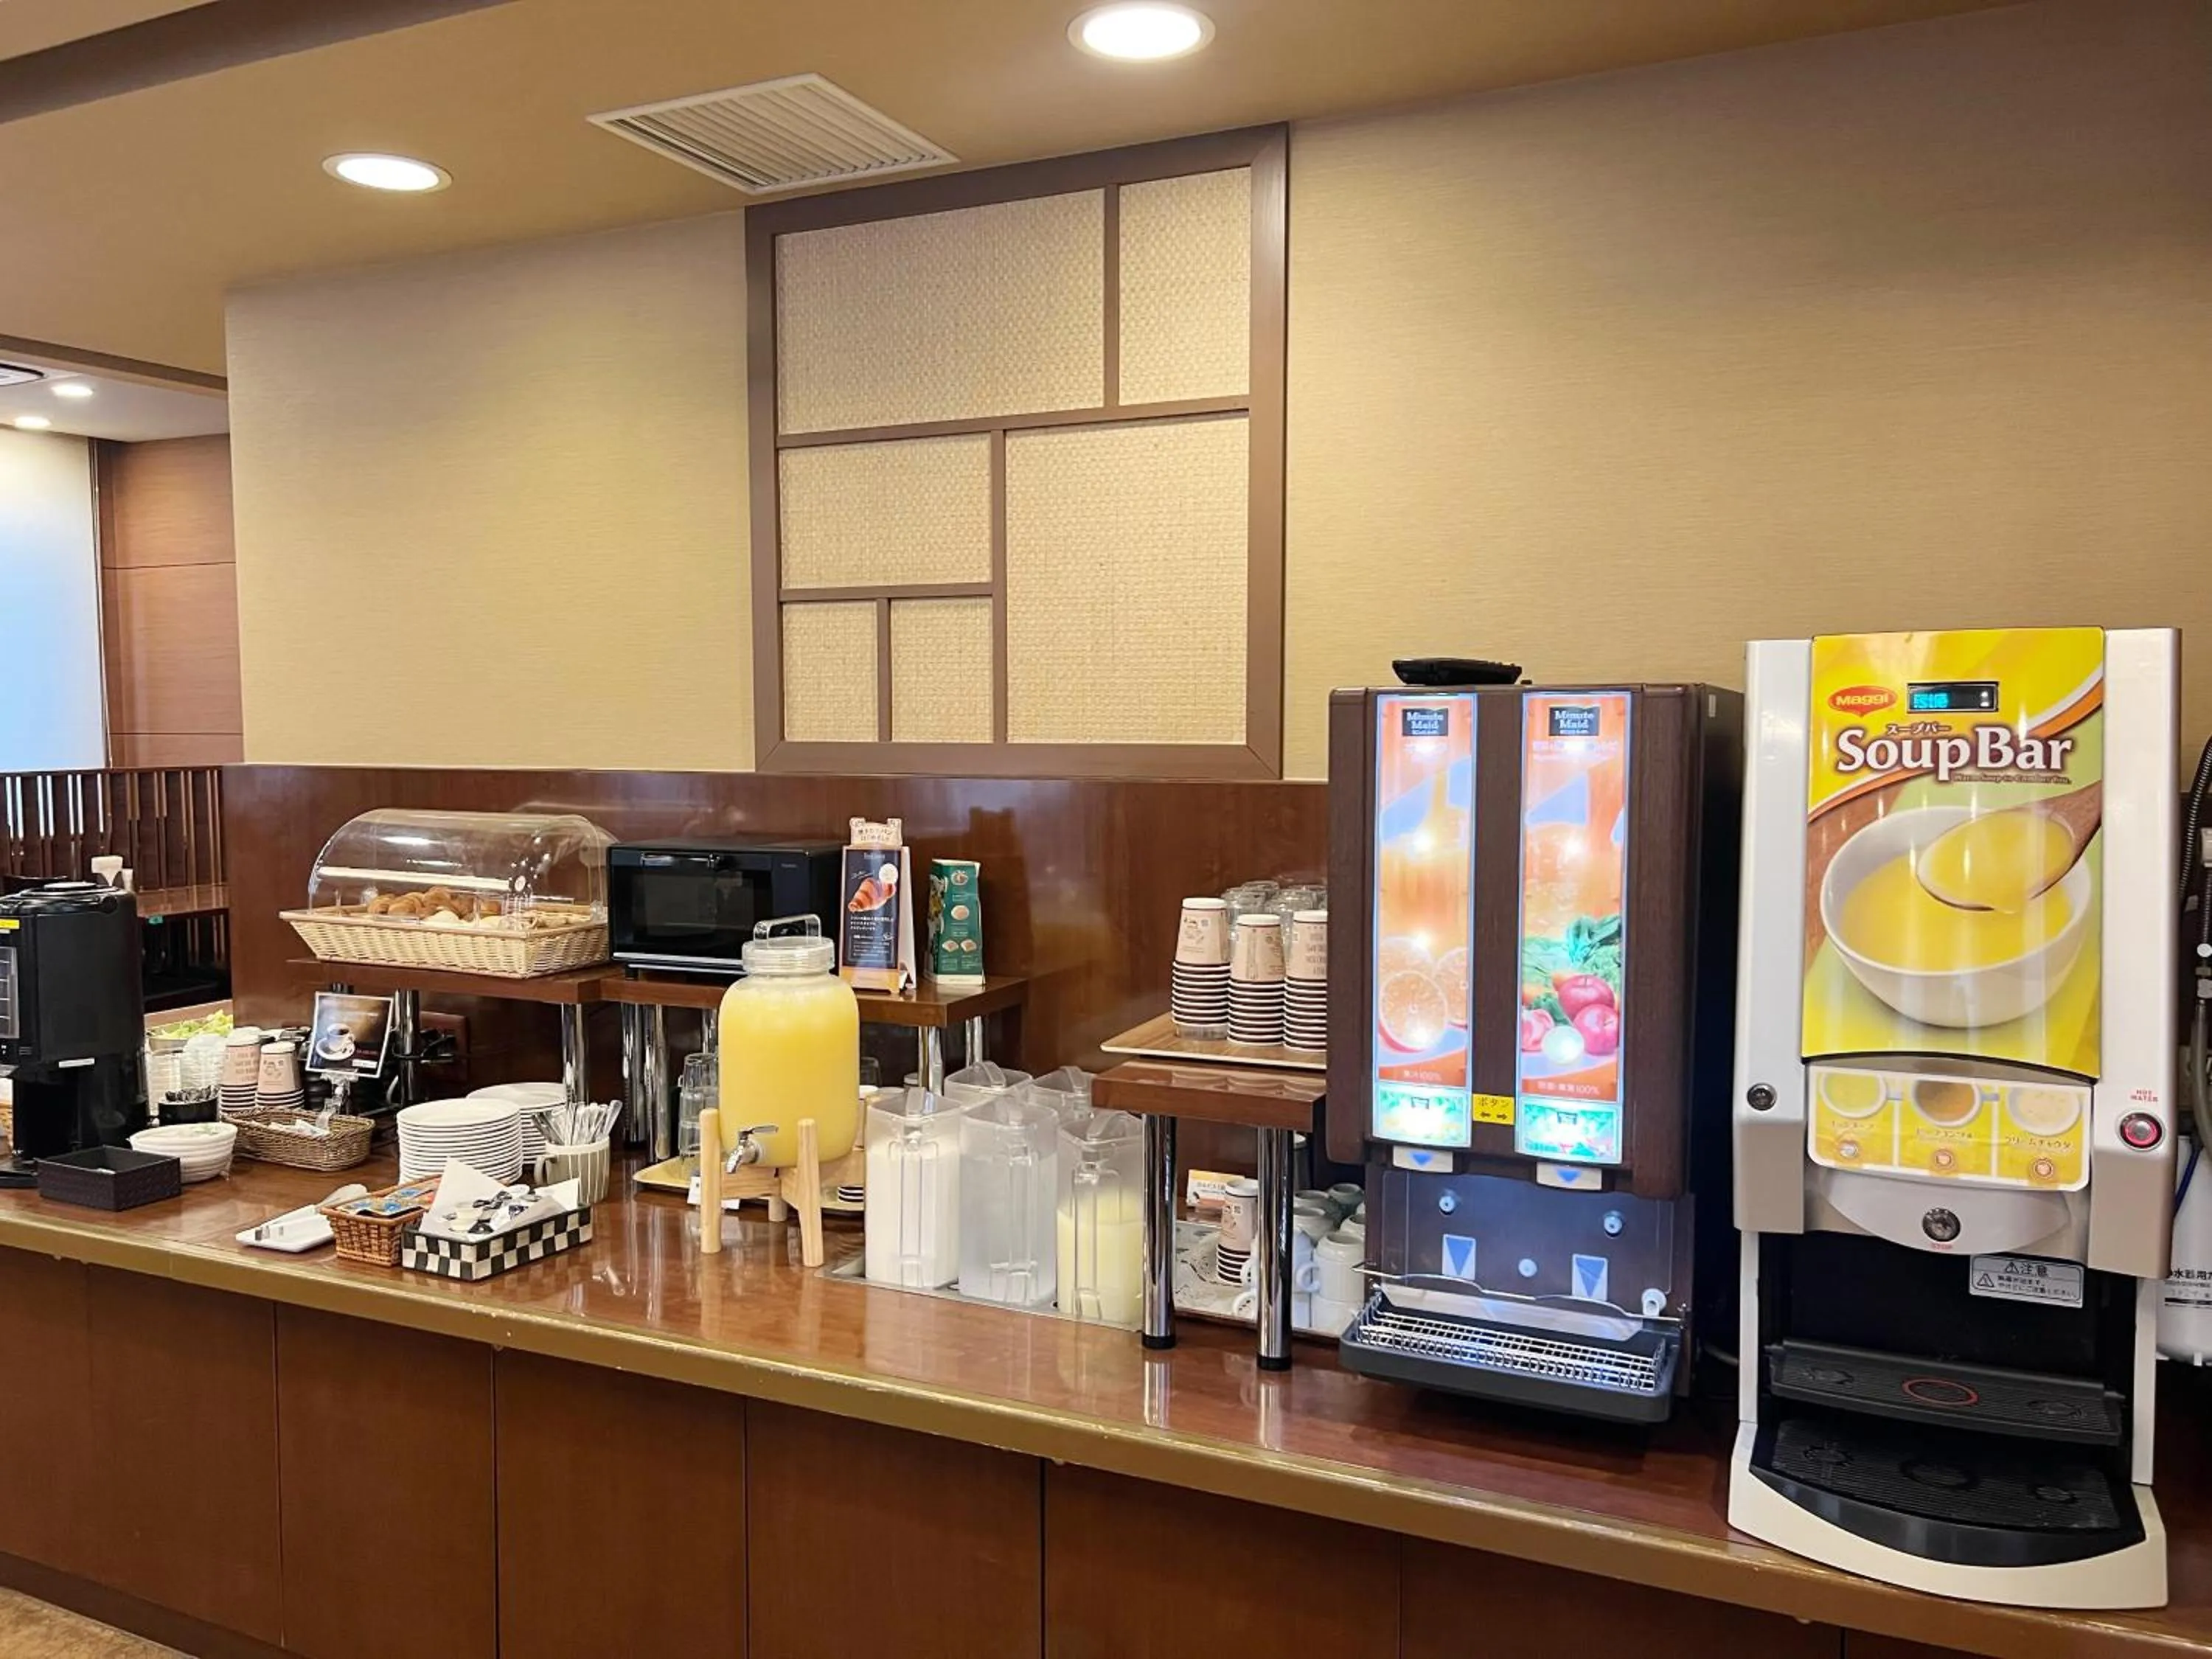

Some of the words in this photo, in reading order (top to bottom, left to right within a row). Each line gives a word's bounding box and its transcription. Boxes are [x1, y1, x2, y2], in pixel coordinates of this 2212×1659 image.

[1554, 710, 1595, 720] Minute
[1559, 719, 1590, 729] Maid
[1837, 729, 1969, 781] Soup
[1976, 726, 2072, 770] Bar
